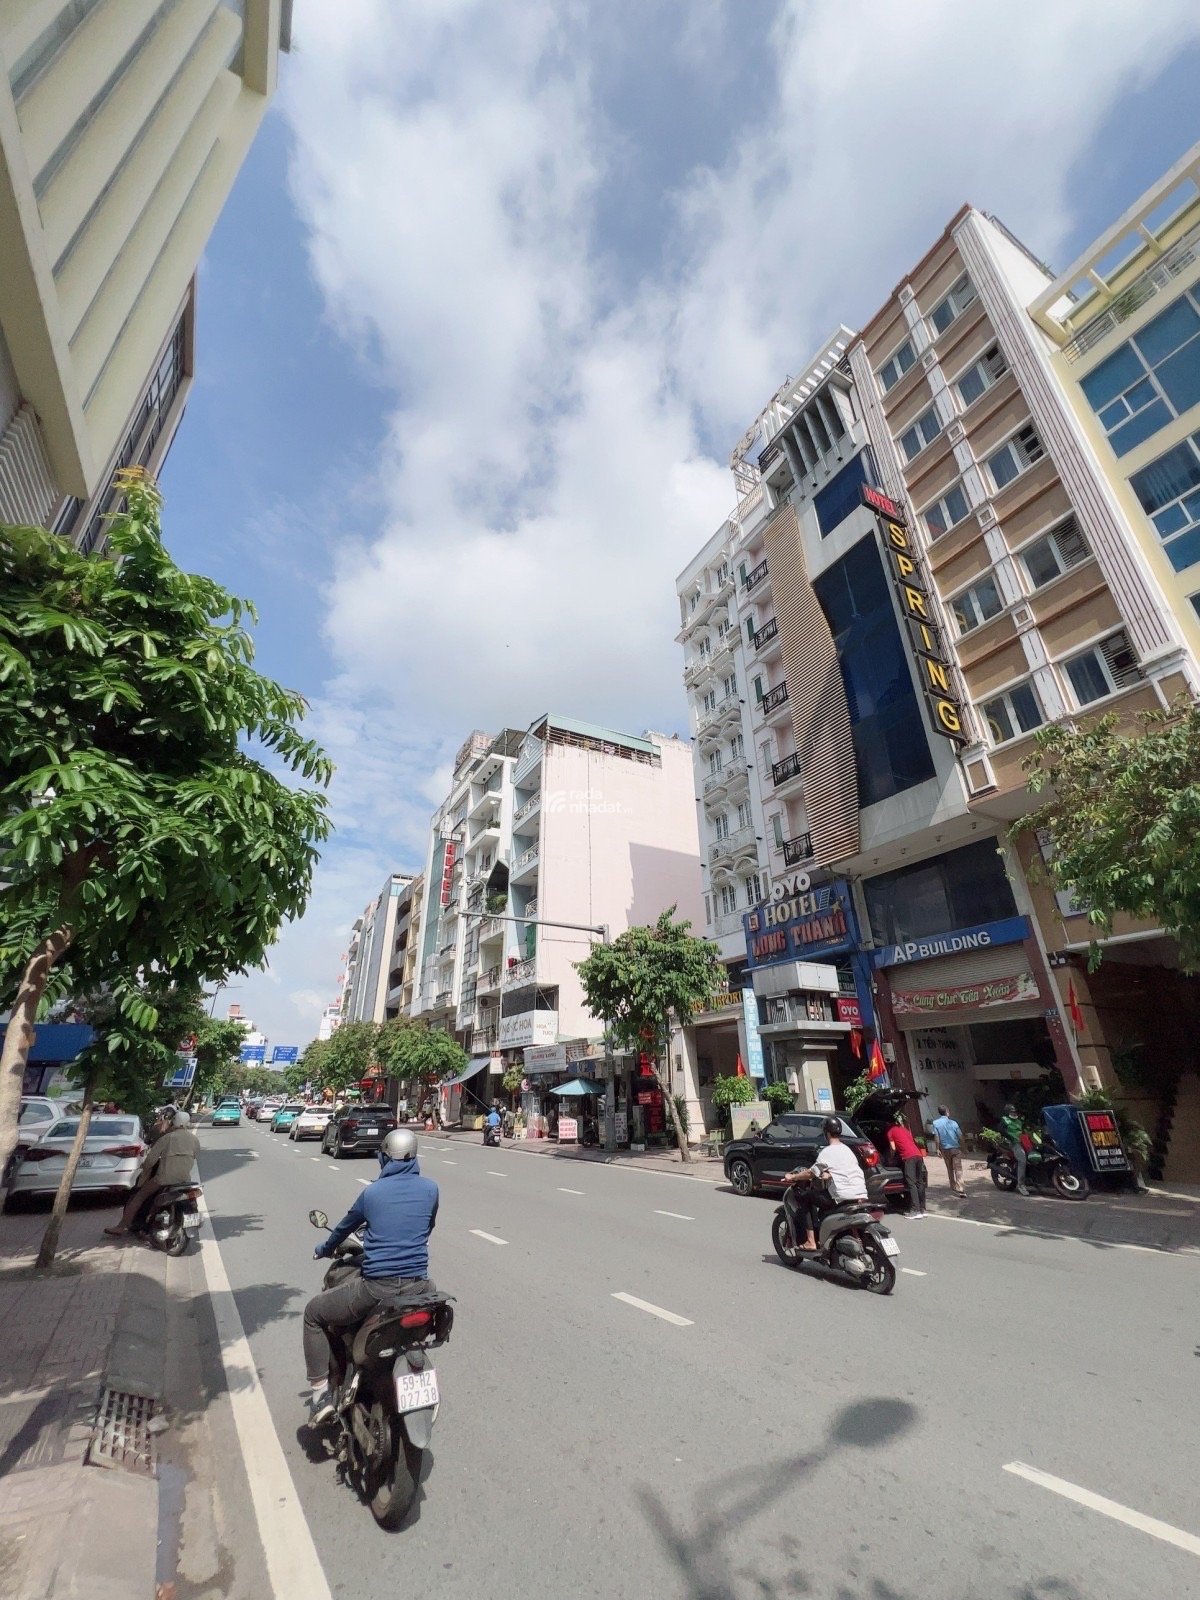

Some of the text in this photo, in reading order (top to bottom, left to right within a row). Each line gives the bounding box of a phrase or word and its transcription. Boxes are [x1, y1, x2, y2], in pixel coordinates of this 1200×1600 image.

[865, 487, 897, 516] HOTEL
[888, 522, 961, 731] SPRING
[441, 843, 456, 904] HOTEL
[771, 871, 810, 902] OYO
[764, 893, 817, 927] HOTEL
[919, 932, 991, 957] BUILDING
[841, 1006, 858, 1015] OYO
[913, 994, 934, 1008] Cung
